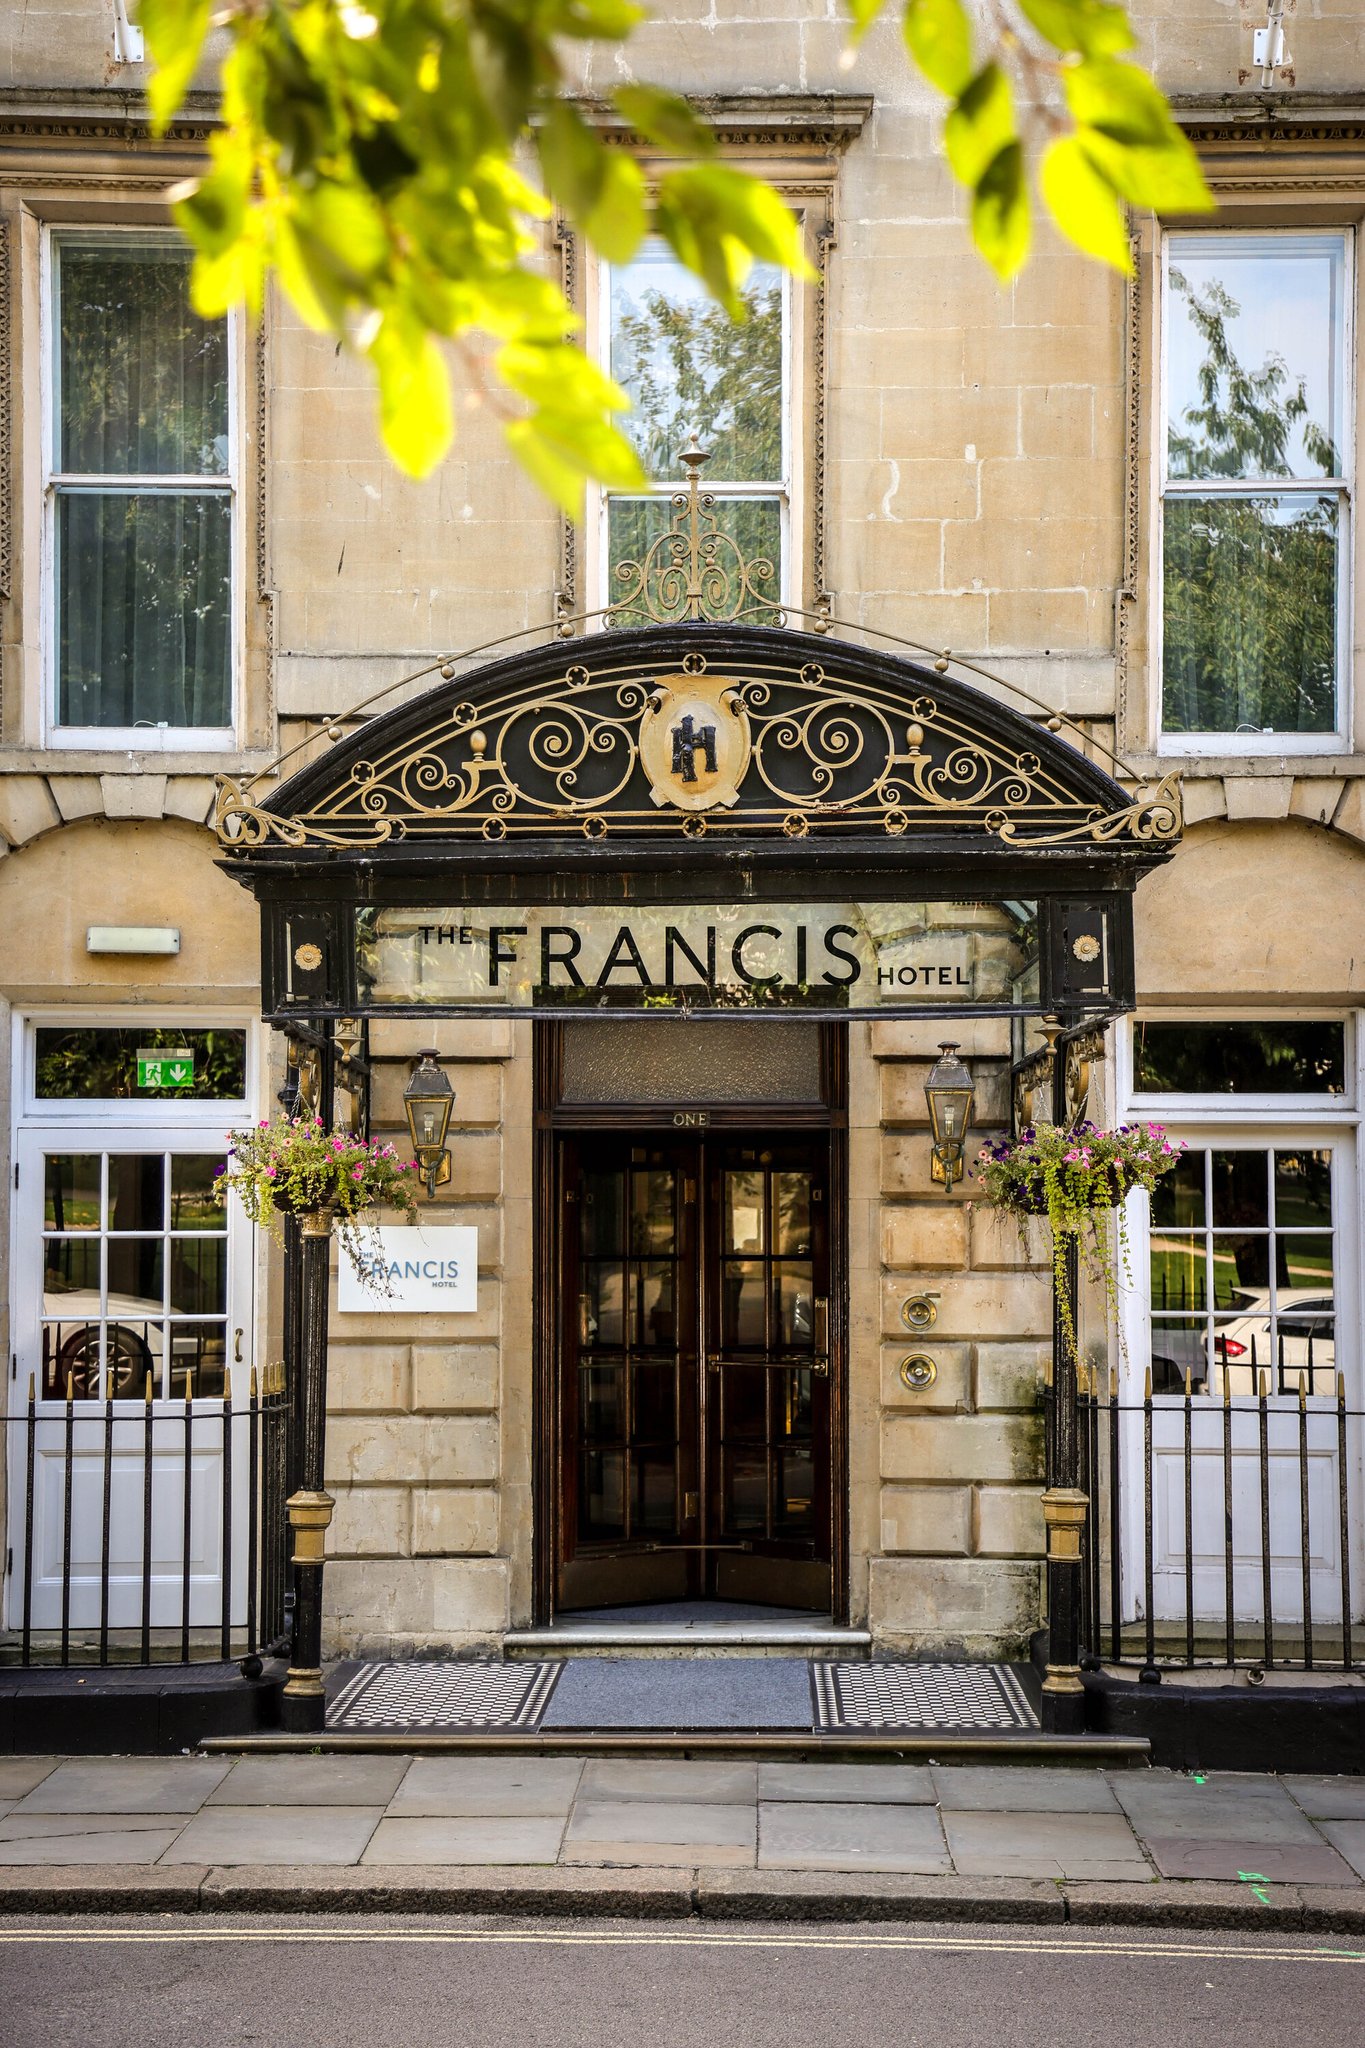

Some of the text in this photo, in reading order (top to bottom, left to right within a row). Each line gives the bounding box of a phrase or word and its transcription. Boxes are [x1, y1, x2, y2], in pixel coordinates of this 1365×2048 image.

[418, 924, 970, 987] THE FRANCIS HOTEL
[673, 1113, 707, 1126] ONE
